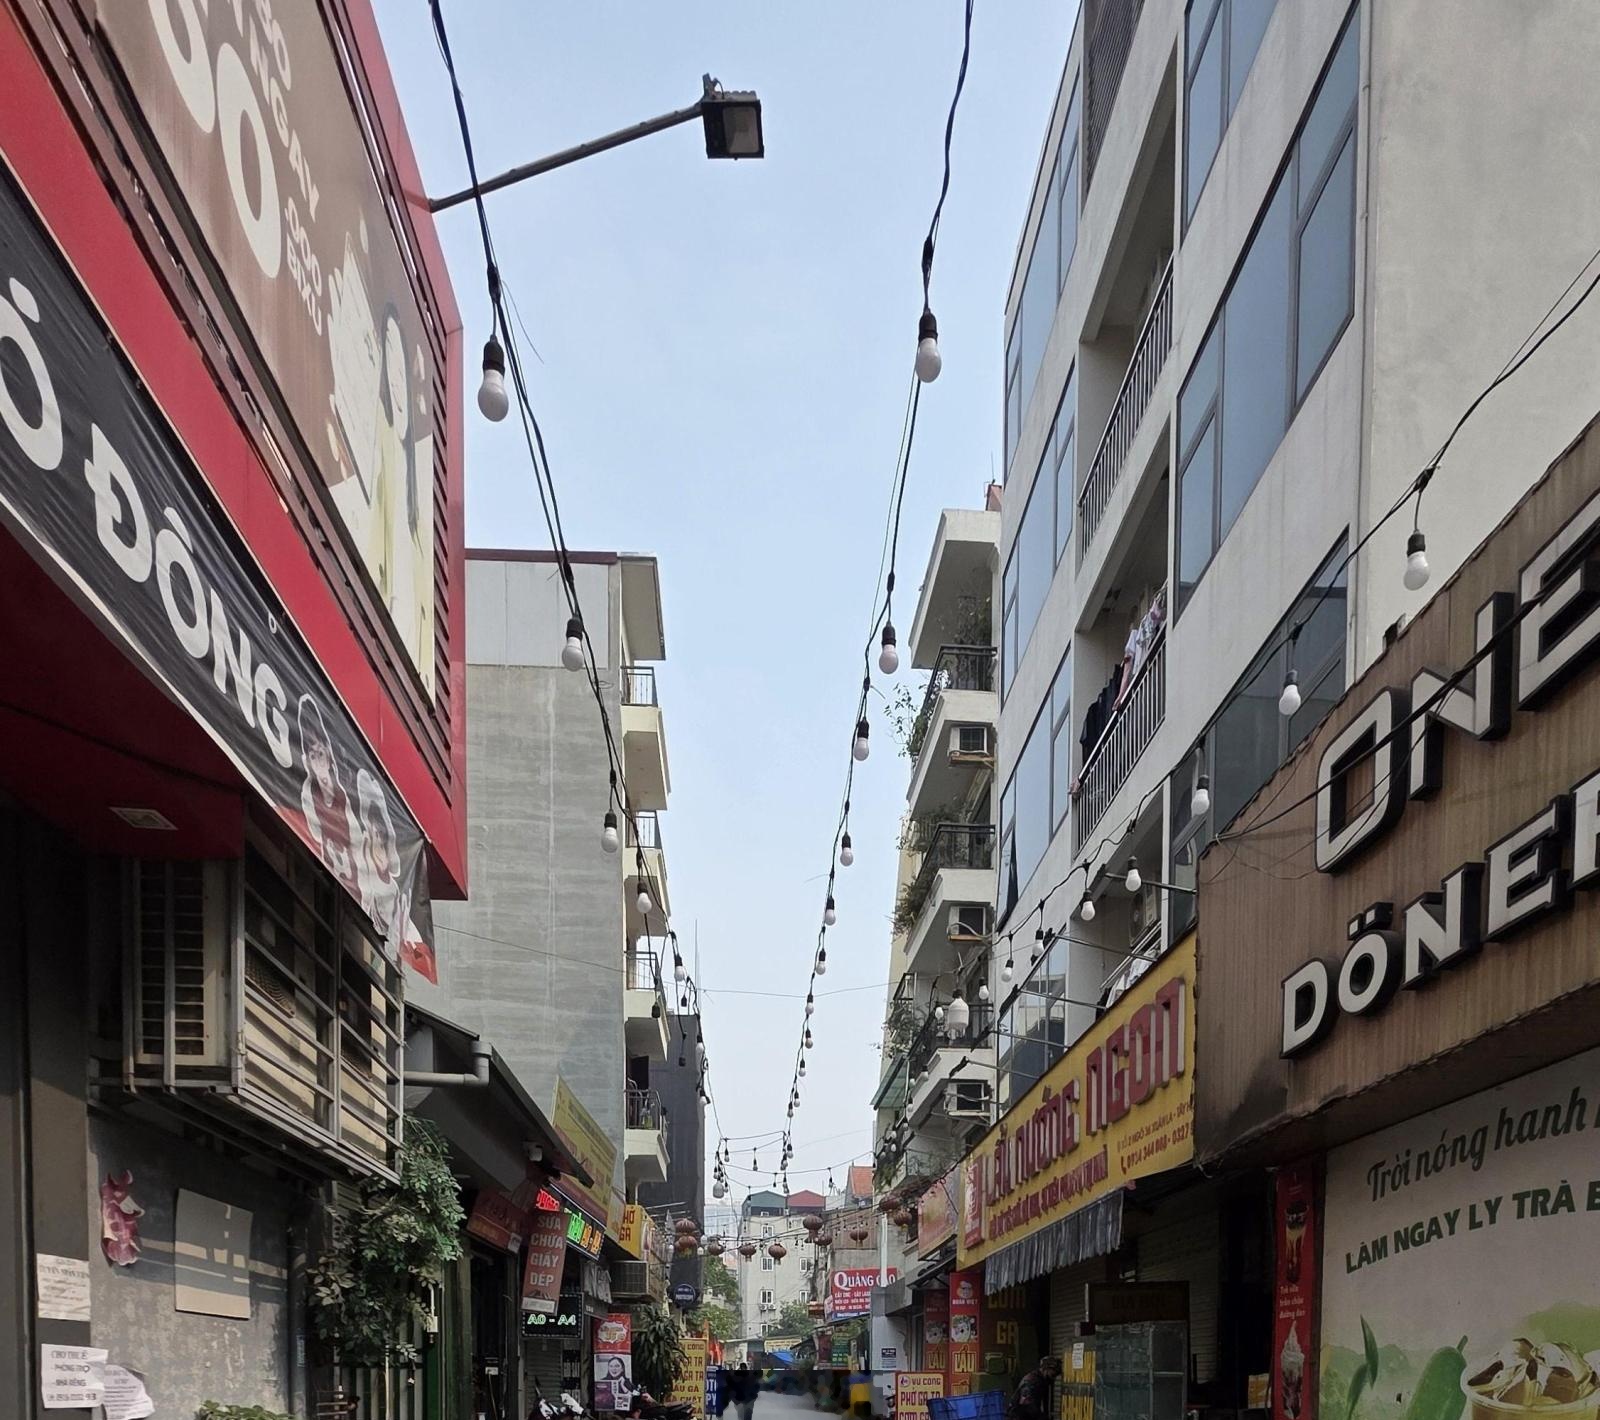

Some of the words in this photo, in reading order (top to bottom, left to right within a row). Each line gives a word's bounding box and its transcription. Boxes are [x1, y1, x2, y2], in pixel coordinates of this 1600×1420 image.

[1085, 976, 1187, 1137] NGON
[1415, 1124, 1488, 1182] nóng
[1494, 1086, 1587, 1151] hanh
[1345, 1235, 1388, 1274] LÀM
[1394, 1208, 1461, 1254] NGAY
[1468, 1196, 1503, 1231] LY
[1512, 1181, 1576, 1220] TRÀ
[557, 1314, 577, 1325] A4
